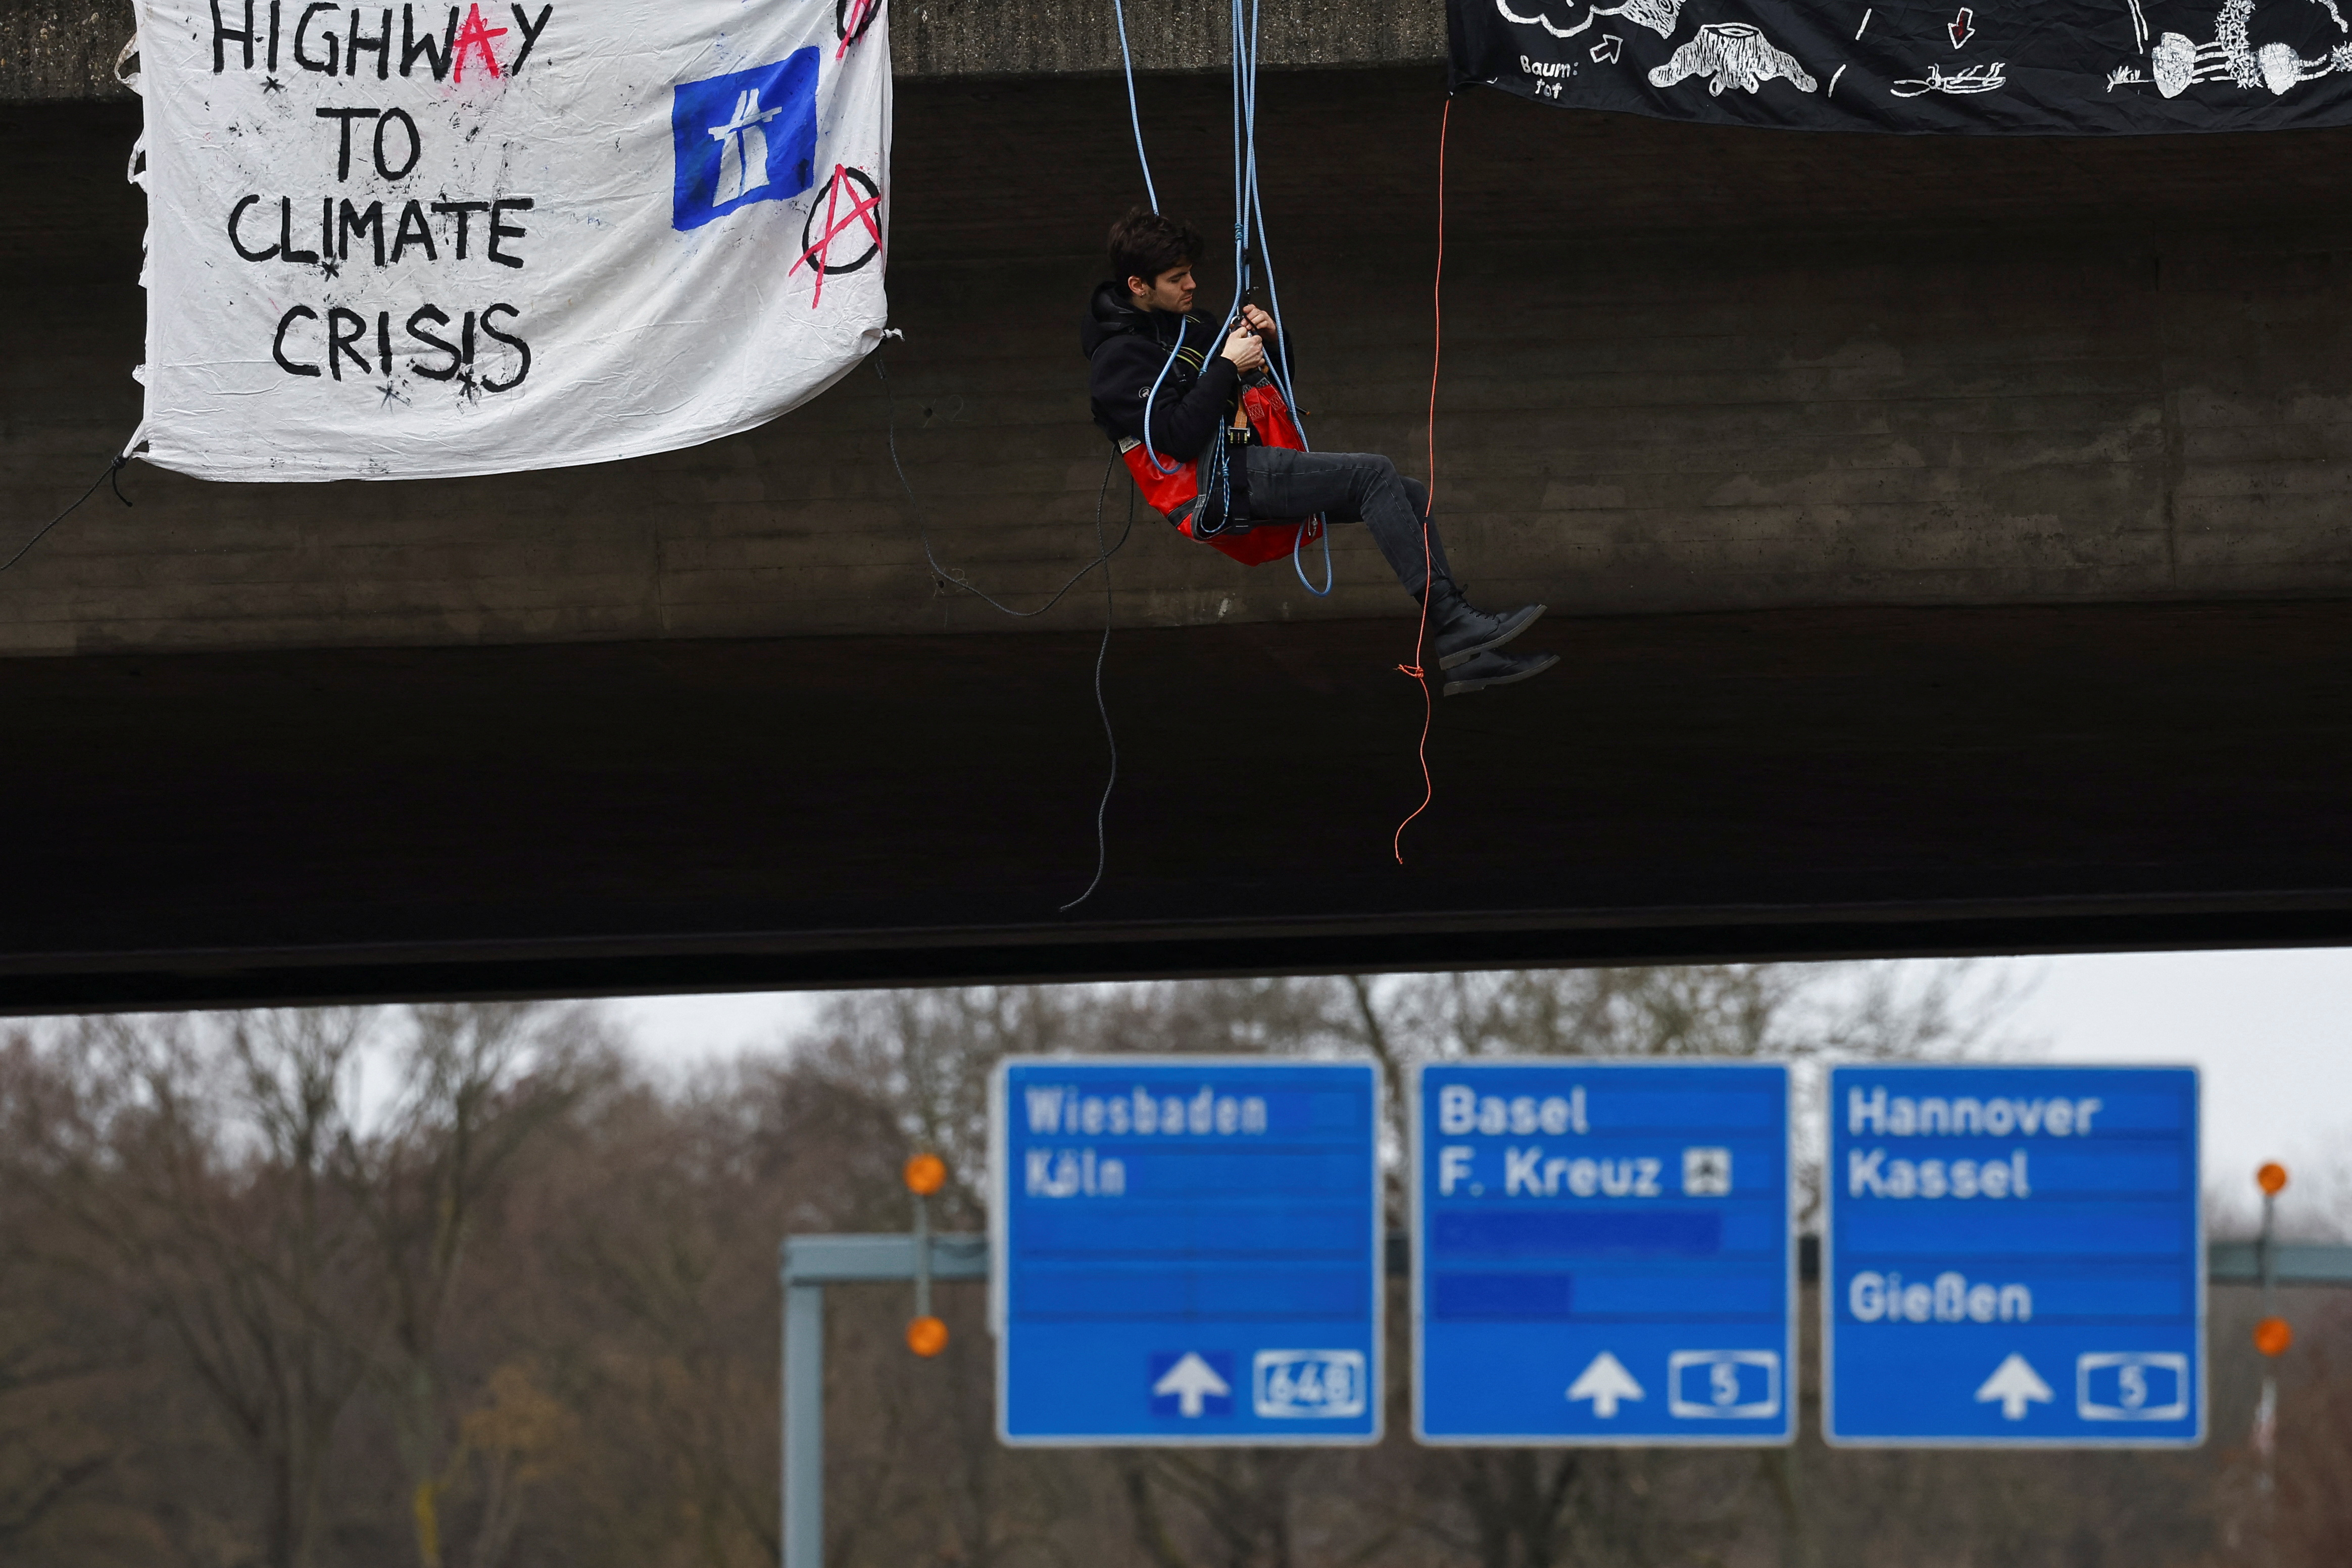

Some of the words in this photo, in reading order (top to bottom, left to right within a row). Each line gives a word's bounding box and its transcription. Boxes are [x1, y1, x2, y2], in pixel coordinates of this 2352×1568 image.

[212, 0, 553, 83] HIGHWAY
[1520, 55, 1579, 78] Baum:
[1535, 78, 1562, 99] tot
[316, 107, 421, 182] TO
[227, 194, 534, 269] CLIMATE
[273, 303, 531, 393] CRISIS
[1025, 1085, 1267, 1135] Wiesbaden
[1440, 1085, 1590, 1135] Basel
[1849, 1086, 2102, 1137] Hannover
[1025, 1147, 1126, 1197] Köln
[1440, 1146, 1484, 1197] F.
[1505, 1146, 1662, 1197] Kreuz
[1849, 1148, 2031, 1199] Kassel
[1849, 1271, 2032, 1322] Gießen
[1709, 1362, 1739, 1405] 5
[2118, 1365, 2148, 1408] 5
